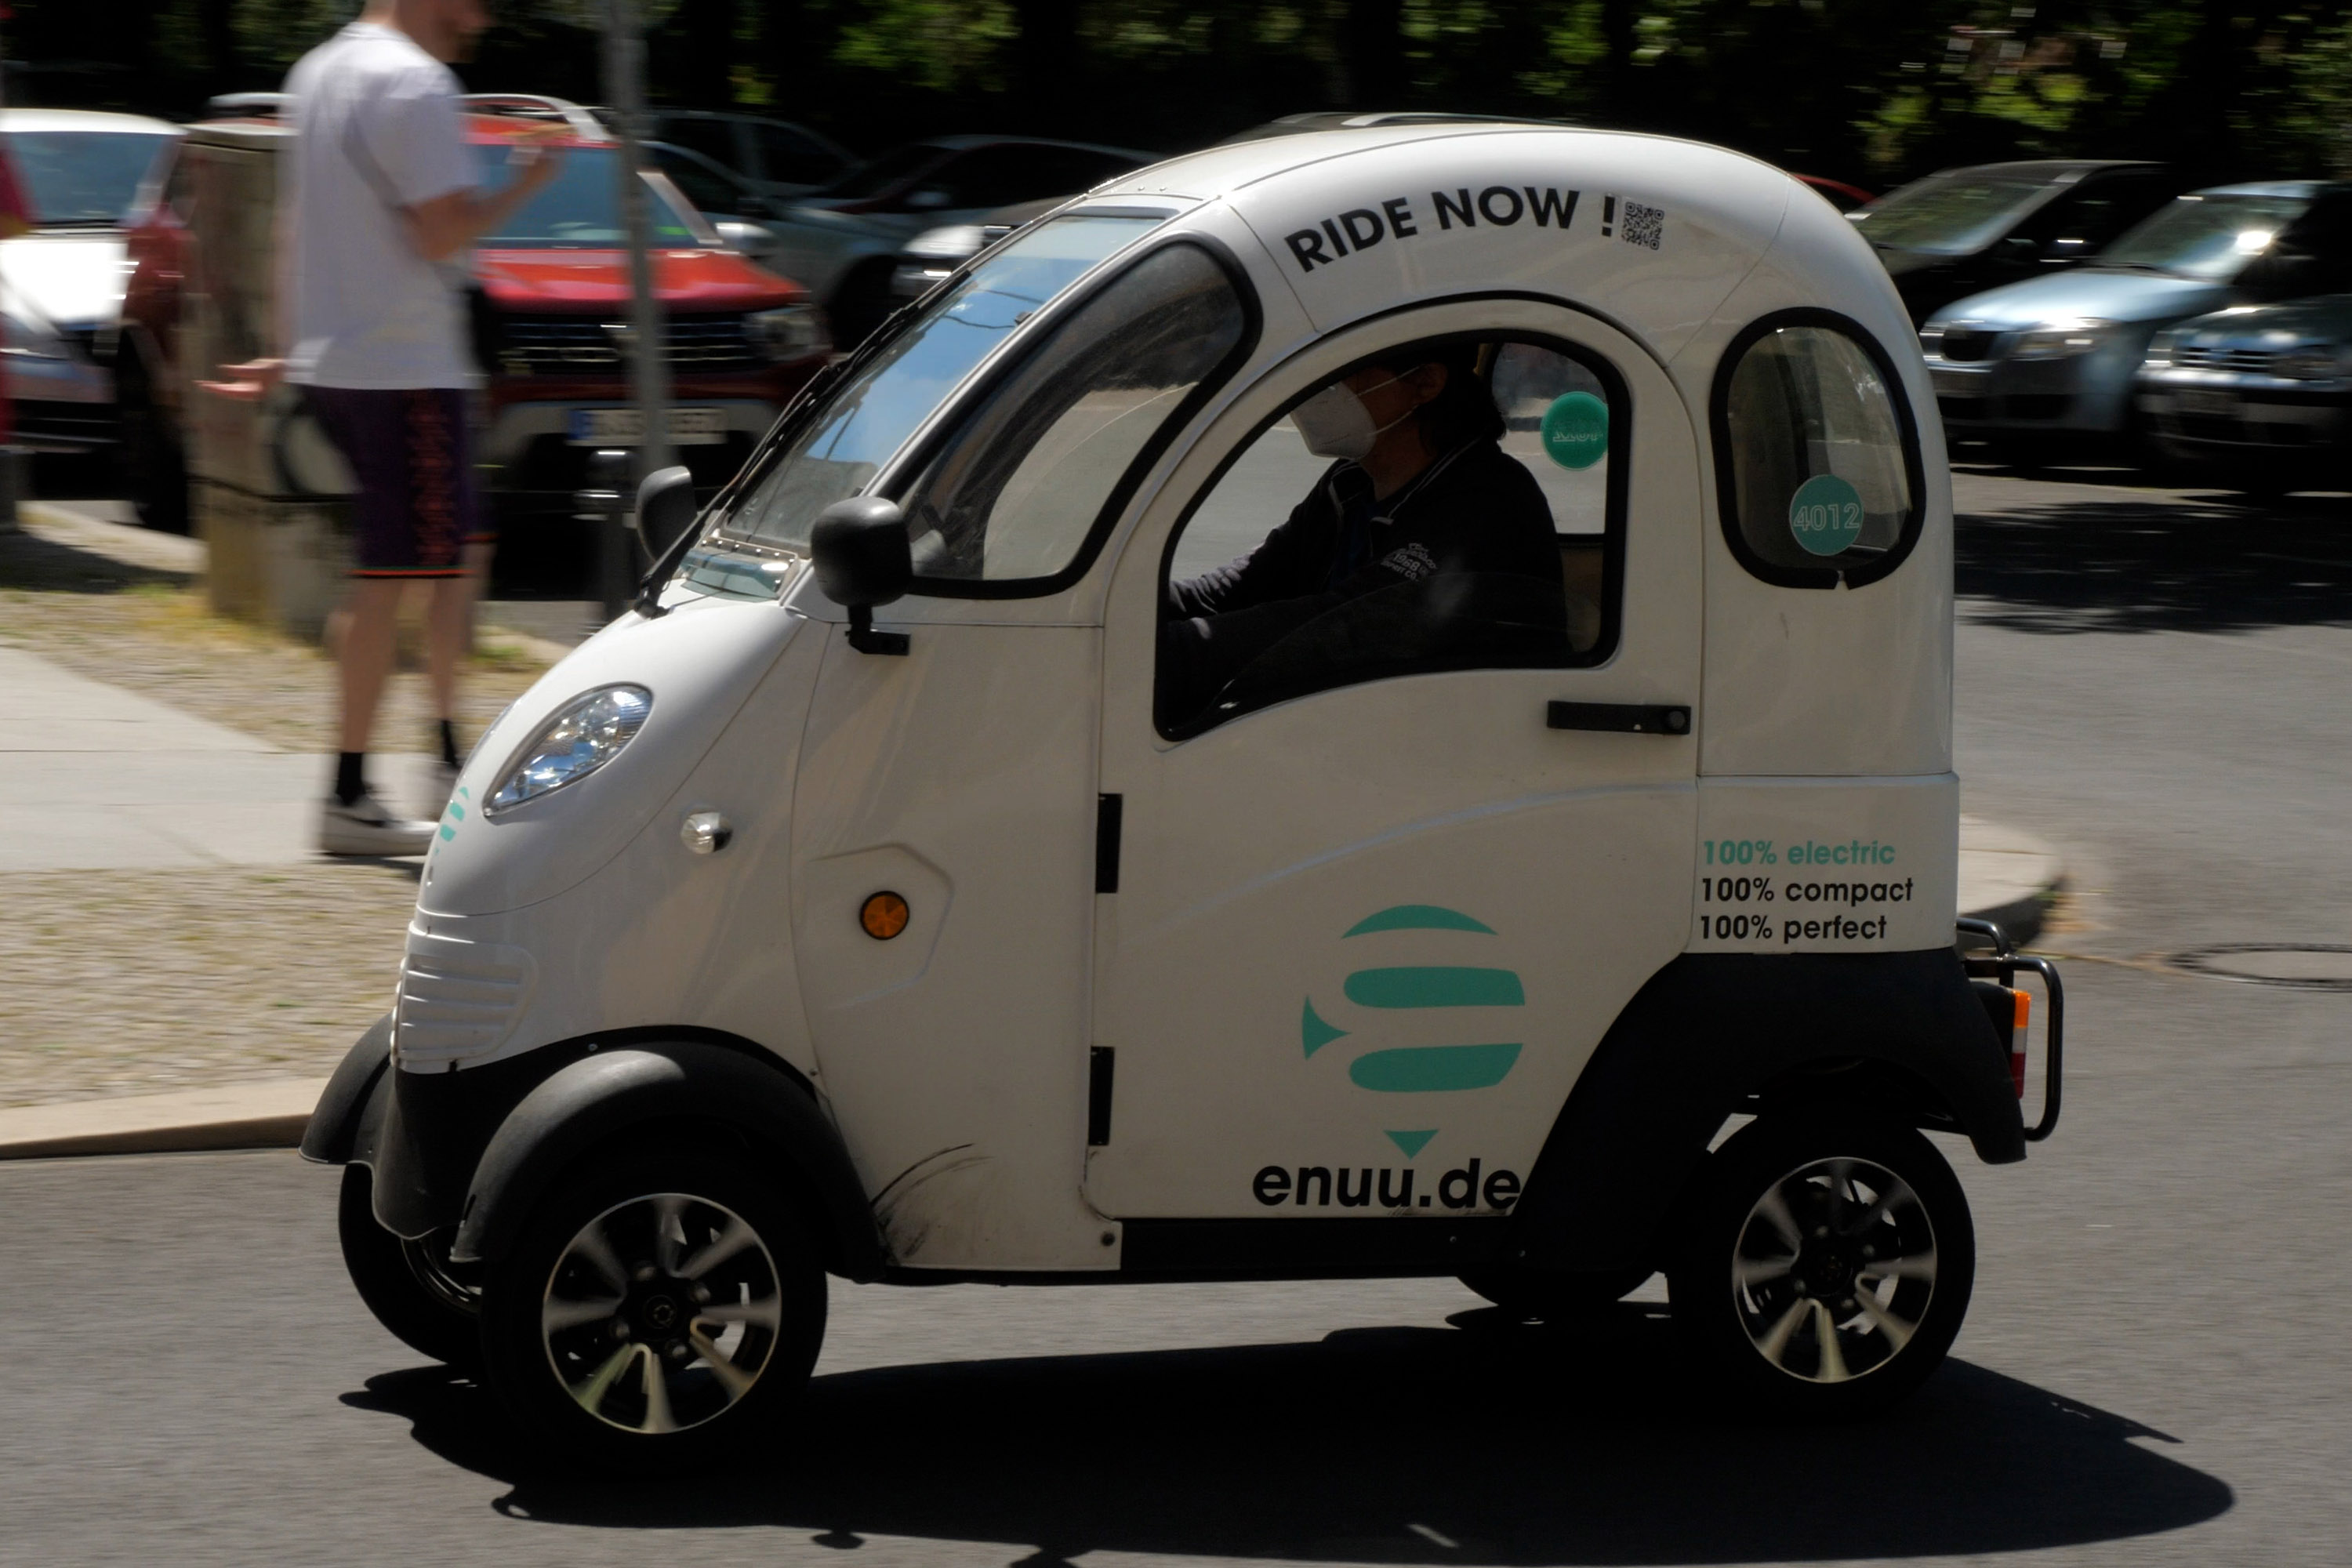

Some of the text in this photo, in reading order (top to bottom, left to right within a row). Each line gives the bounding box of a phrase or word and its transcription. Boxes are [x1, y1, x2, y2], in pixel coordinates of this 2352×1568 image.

[1283, 197, 1417, 273] RIDE
[1431, 185, 1580, 230] NOW
[1793, 503, 1860, 532] 4012
[1704, 840, 1896, 865] 100% electric
[1702, 877, 1913, 907] 100% compact
[1700, 915, 1887, 944] 100% perfect
[1252, 1158, 1521, 1210] enuu.de
